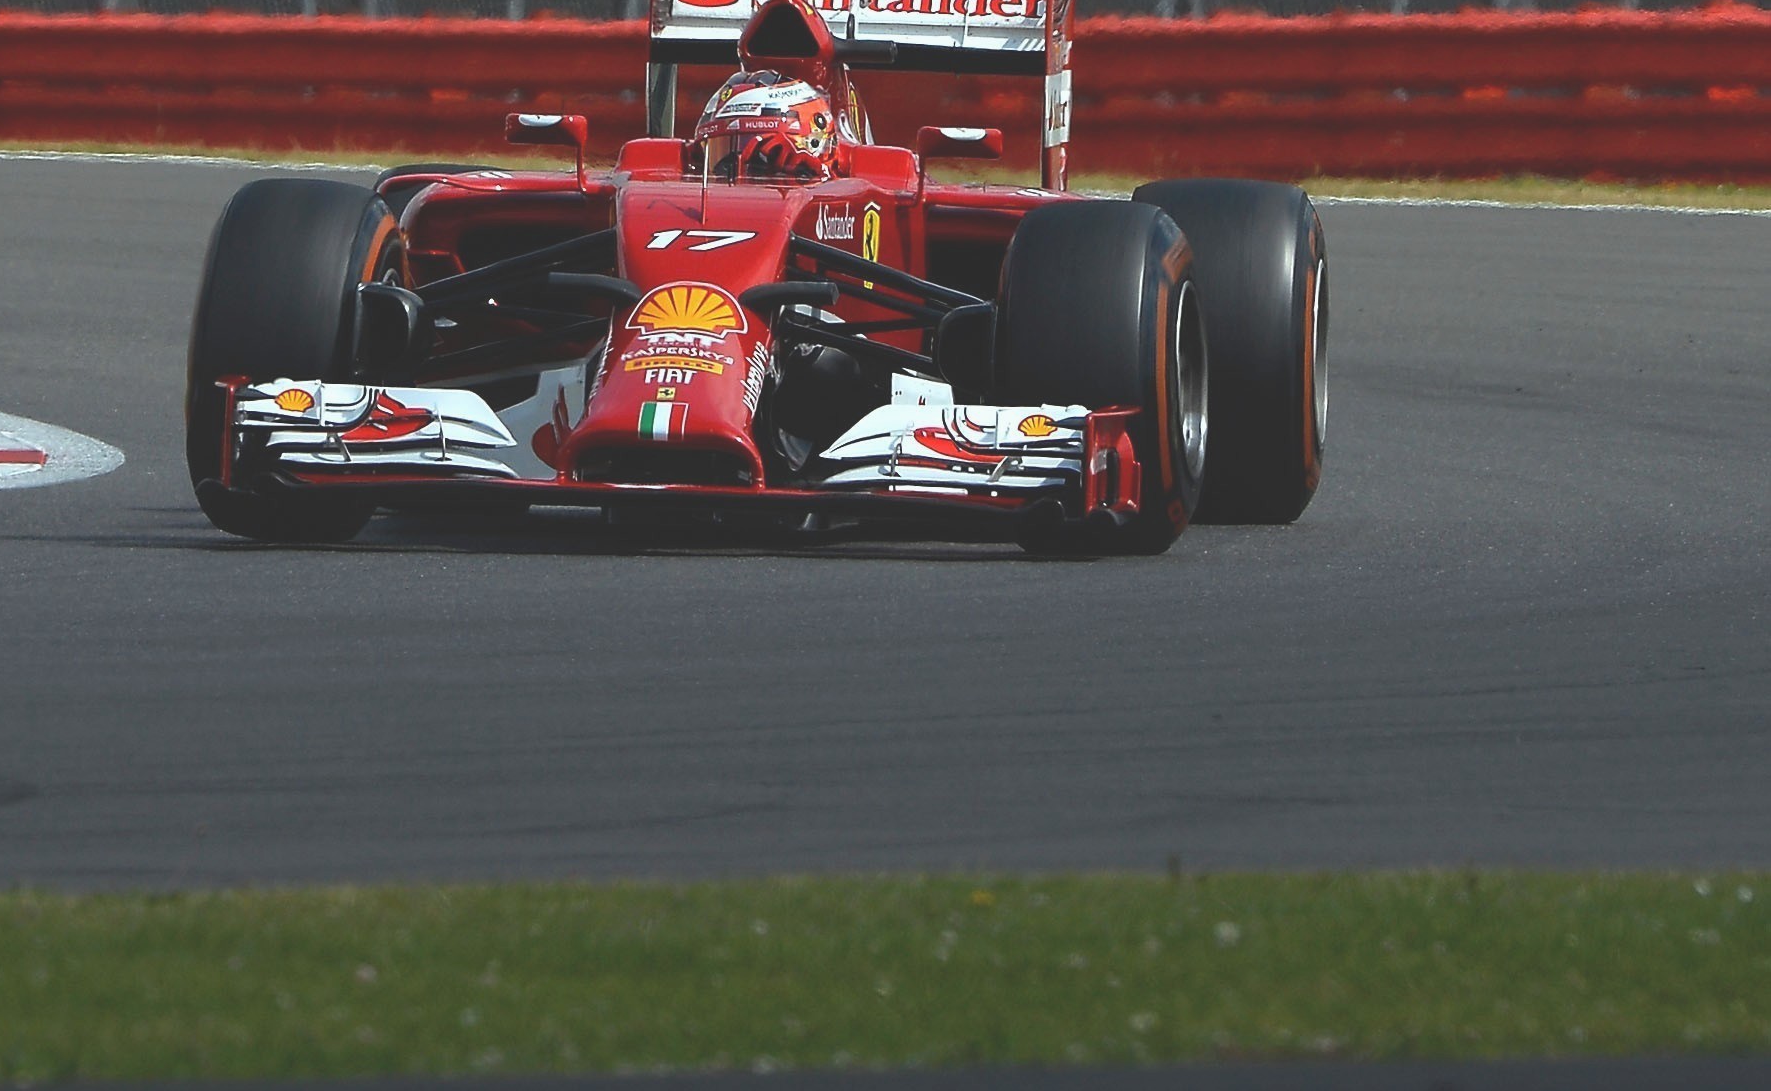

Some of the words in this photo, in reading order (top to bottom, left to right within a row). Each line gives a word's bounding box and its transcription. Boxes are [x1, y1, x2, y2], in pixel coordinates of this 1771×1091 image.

[745, 121, 780, 129] HUBLOT
[646, 229, 756, 251] 17
[637, 332, 726, 348] TNT
[620, 347, 725, 362] KASPERSKY
[644, 368, 698, 385] FIAT
